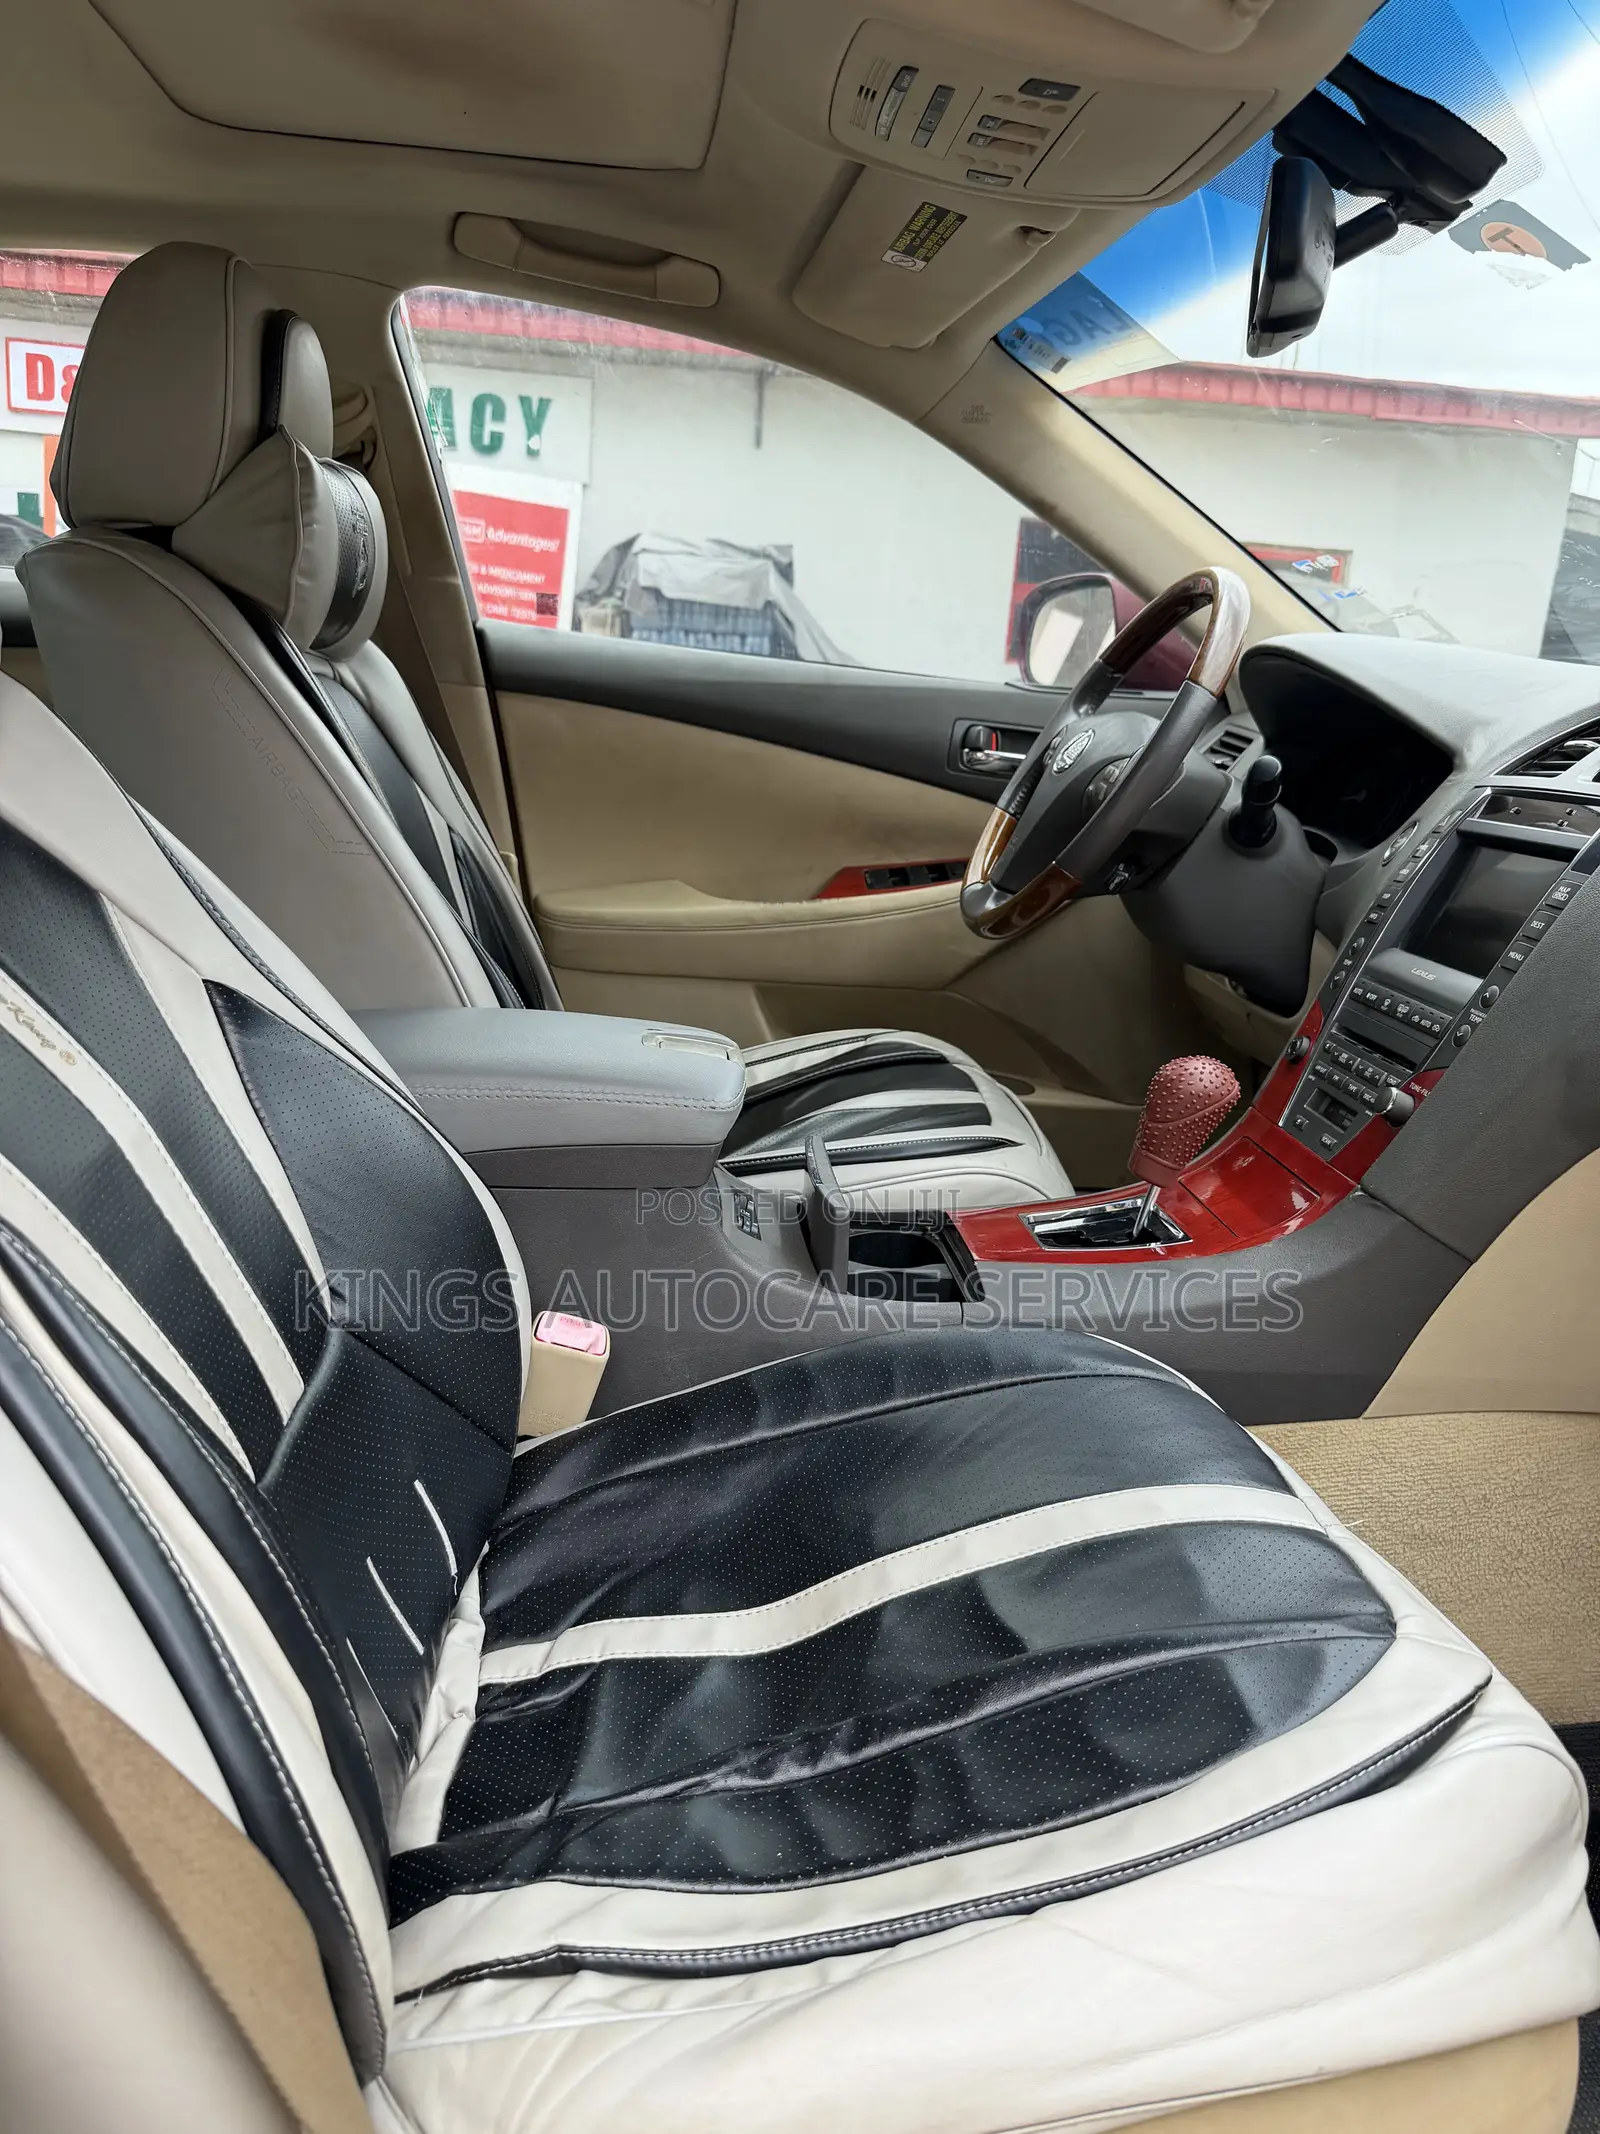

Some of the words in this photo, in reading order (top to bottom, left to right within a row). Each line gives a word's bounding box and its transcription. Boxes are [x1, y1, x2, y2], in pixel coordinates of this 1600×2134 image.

[893, 231, 915, 251] AIRBAG
[908, 204, 936, 231] WARNING
[250, 736, 304, 801] AIRBAG
[1530, 920, 1546, 930] DEST
[1507, 950, 1525, 962] MENU
[1410, 966, 1437, 981] LEXUS
[1469, 1013, 1483, 1024] TEMP
